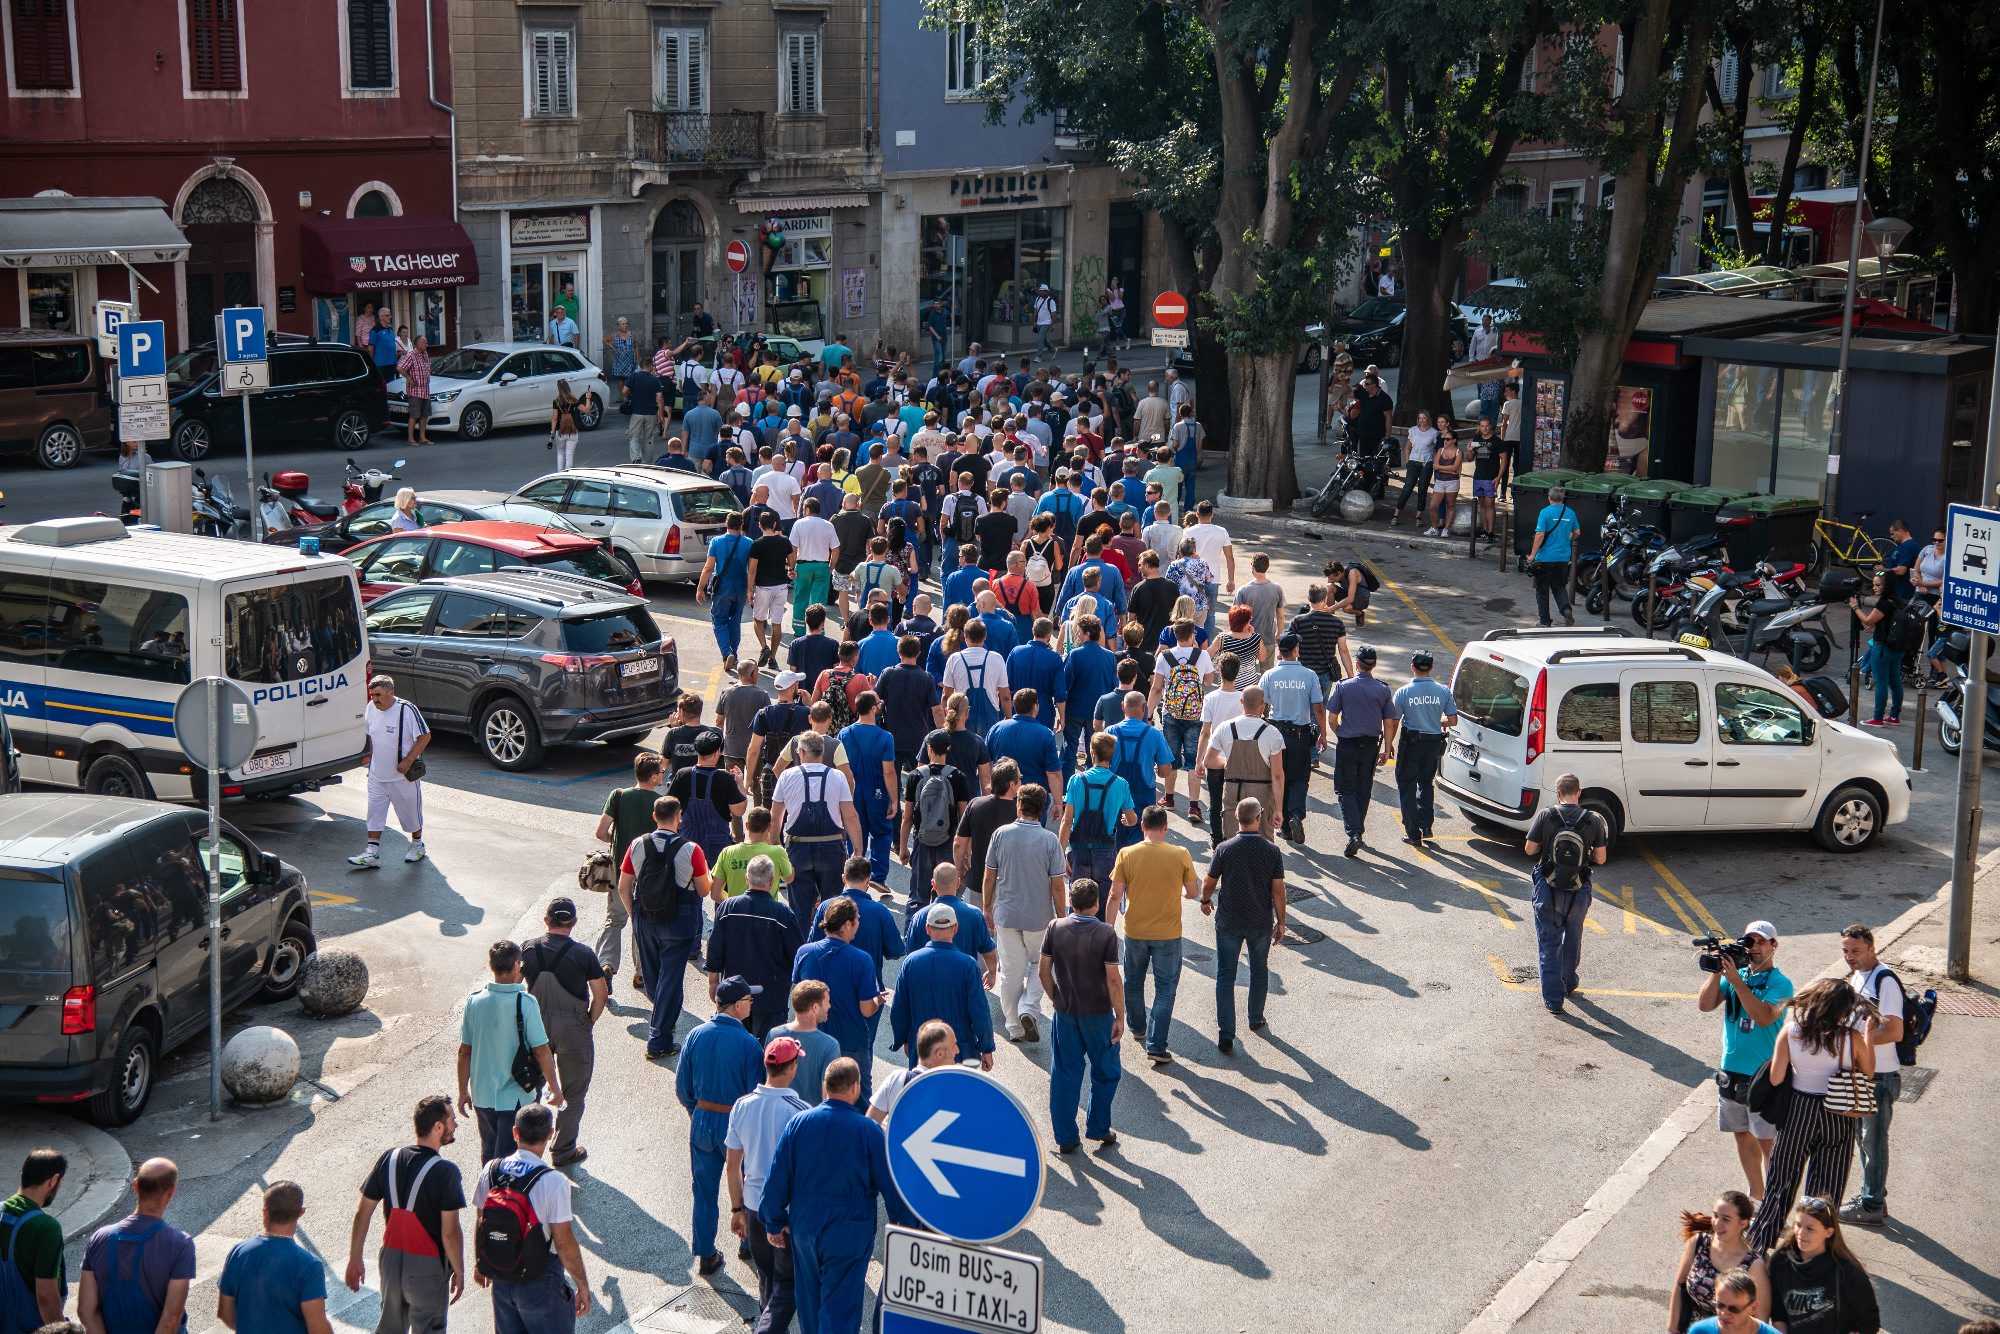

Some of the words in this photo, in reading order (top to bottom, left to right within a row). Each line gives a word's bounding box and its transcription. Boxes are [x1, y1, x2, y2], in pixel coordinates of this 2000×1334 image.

[950, 174, 1049, 195] PAPIRNICA
[783, 219, 823, 231] ARDINI
[355, 281, 381, 289] WATCH
[381, 279, 402, 288] SHOP
[408, 277, 443, 286] JEWELRY
[443, 275, 465, 284] DAVID
[109, 314, 119, 332] P
[236, 318, 254, 351] P
[132, 333, 152, 367] P
[1964, 523, 1992, 542] Taxi
[1948, 582, 1972, 598] Taxi
[1974, 587, 1998, 604] Pula
[1954, 600, 1988, 617] Giardini
[1952, 613, 1964, 622] 385
[1964, 616, 1973, 625] 52
[1974, 618, 1986, 627] 223
[1986, 621, 1999, 631] 228
[253, 673, 349, 706] POLICIJA
[1274, 680, 1306, 690] POLICIJA
[1408, 695, 1441, 706] POLICIJA
[269, 754, 285, 767] 385
[910, 1242, 950, 1274] Osim
[959, 1253, 1018, 1294] BUS-a,
[893, 1275, 944, 1309] JGP-a
[952, 1288, 957, 1312] i
[966, 1290, 1027, 1328] TAXI-a
[1785, 1292, 1821, 1313] NIKE
